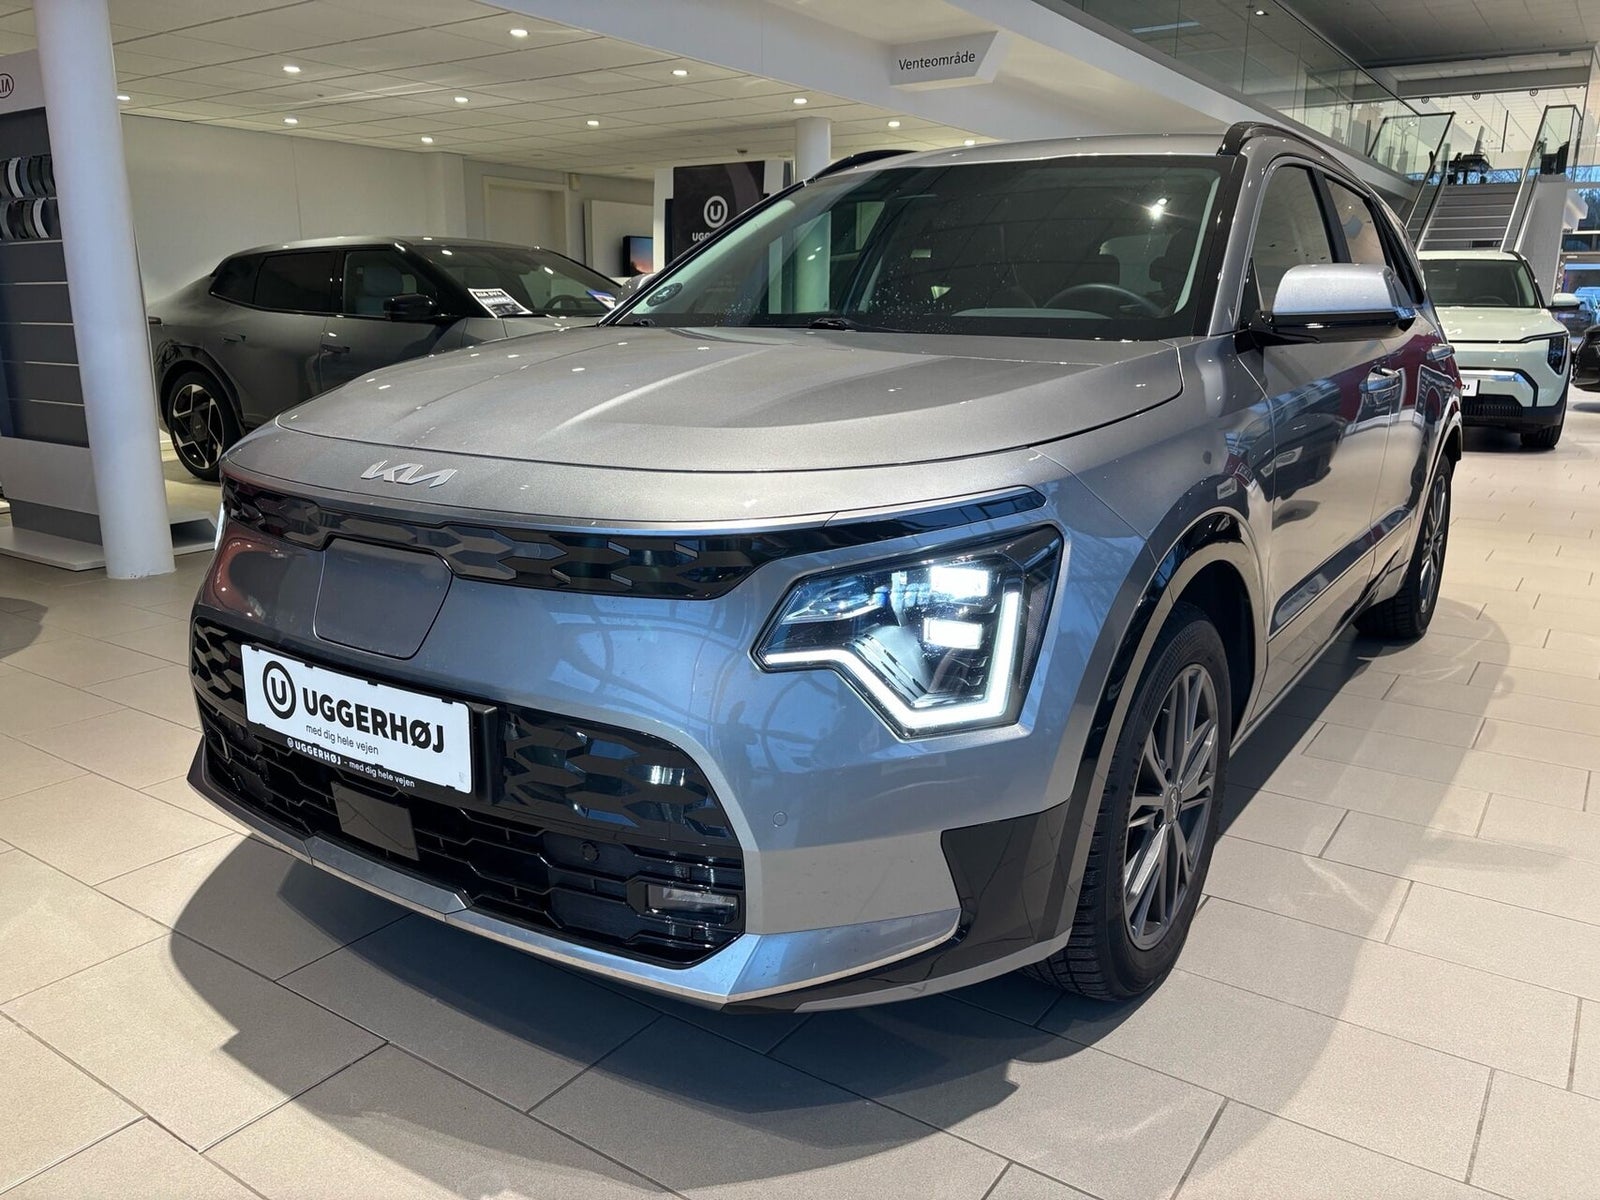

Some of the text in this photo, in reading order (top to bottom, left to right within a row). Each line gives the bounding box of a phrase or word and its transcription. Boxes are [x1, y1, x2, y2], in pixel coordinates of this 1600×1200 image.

[898, 51, 976, 70] Venteområde
[0, 79, 11, 93] IA
[302, 687, 445, 754] UGGERHØJ
[305, 724, 379, 755] med dig hele vejen
[294, 741, 342, 766] UGGERHØJ
[349, 761, 364, 772] med
[365, 766, 377, 778] dig
[378, 768, 394, 781] hele
[395, 777, 415, 788] vejen
